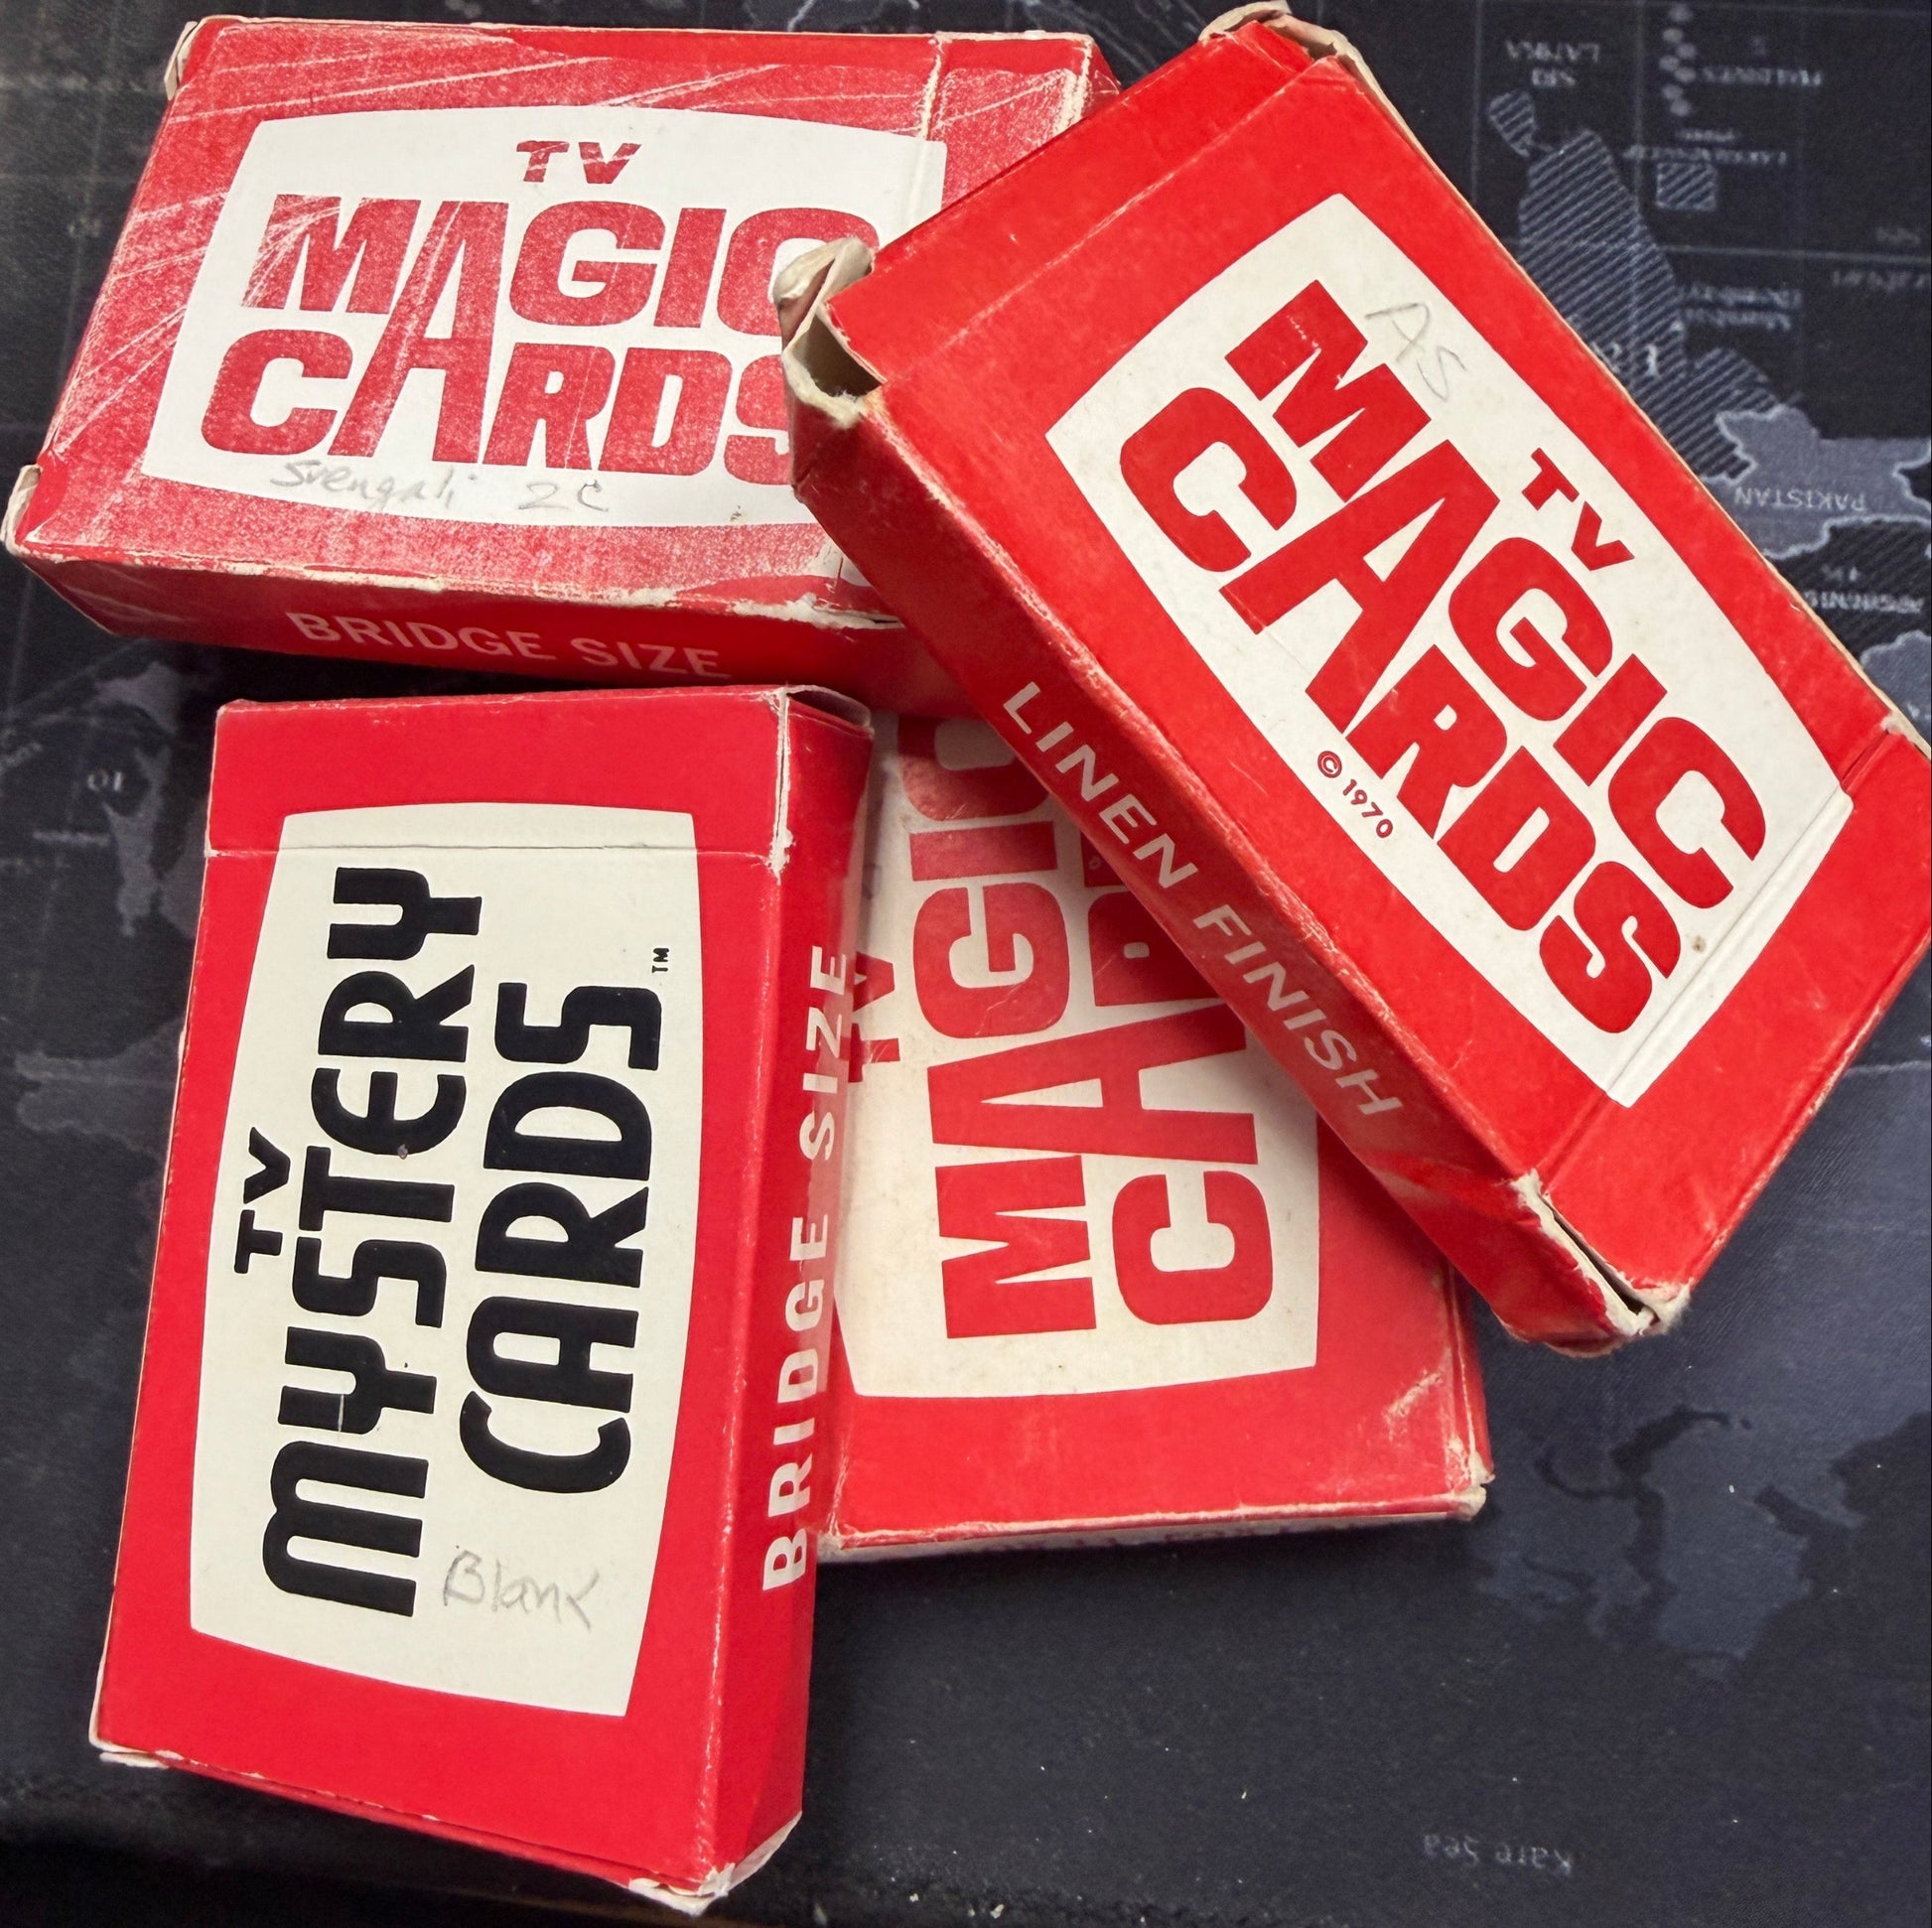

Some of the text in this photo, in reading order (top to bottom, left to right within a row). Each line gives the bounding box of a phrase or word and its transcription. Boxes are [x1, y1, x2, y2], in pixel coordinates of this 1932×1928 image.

[240, 195, 880, 397] MAGIC
[516, 140, 642, 185] TV
[287, 612, 730, 679] BRIDGE SIZE
[1223, 279, 1767, 910] MAGIC
[1521, 447, 1636, 572] TV
[1733, 485, 1867, 513] PAKISTAN
[1118, 387, 1682, 1033] CARDS
[1341, 777, 1395, 840] 1970
[897, 712, 1176, 1339] MAGIC
[1003, 681, 1404, 1118] LINEN FINISH
[233, 1127, 292, 1275] TV
[261, 866, 483, 1619] MYSTERY
[459, 981, 664, 1495] CARDS
[760, 946, 848, 1591] BRIDGE SIZE
